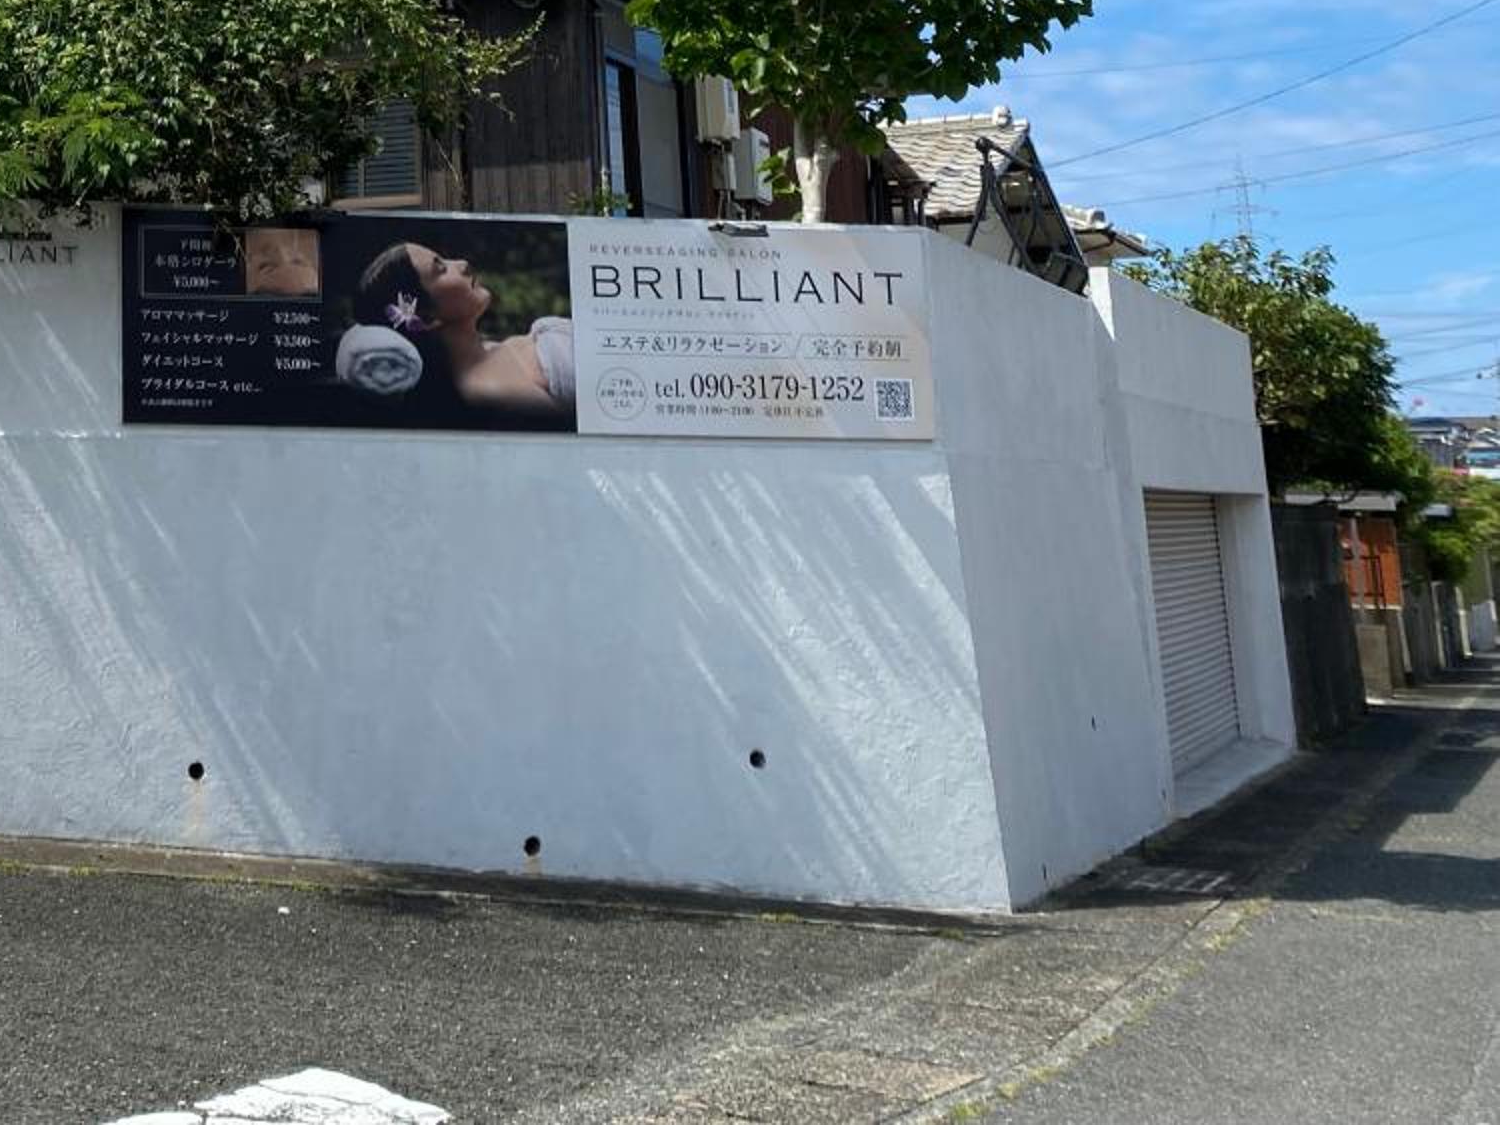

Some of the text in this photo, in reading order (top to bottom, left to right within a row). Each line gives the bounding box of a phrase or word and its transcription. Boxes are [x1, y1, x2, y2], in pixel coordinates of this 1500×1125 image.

[727, 247, 782, 261] SALON
[590, 265, 903, 305] BRILLIANT
[140, 308, 230, 323] アロママッサージ
[141, 331, 259, 346] フェイシャルマッサージ
[602, 335, 902, 359] エステ&リラクゼーション 完全予約制
[141, 354, 224, 368] ダイエットコース
[141, 378, 229, 392] ブライダルコース
[654, 372, 865, 402] tel. 090-3179-1252
